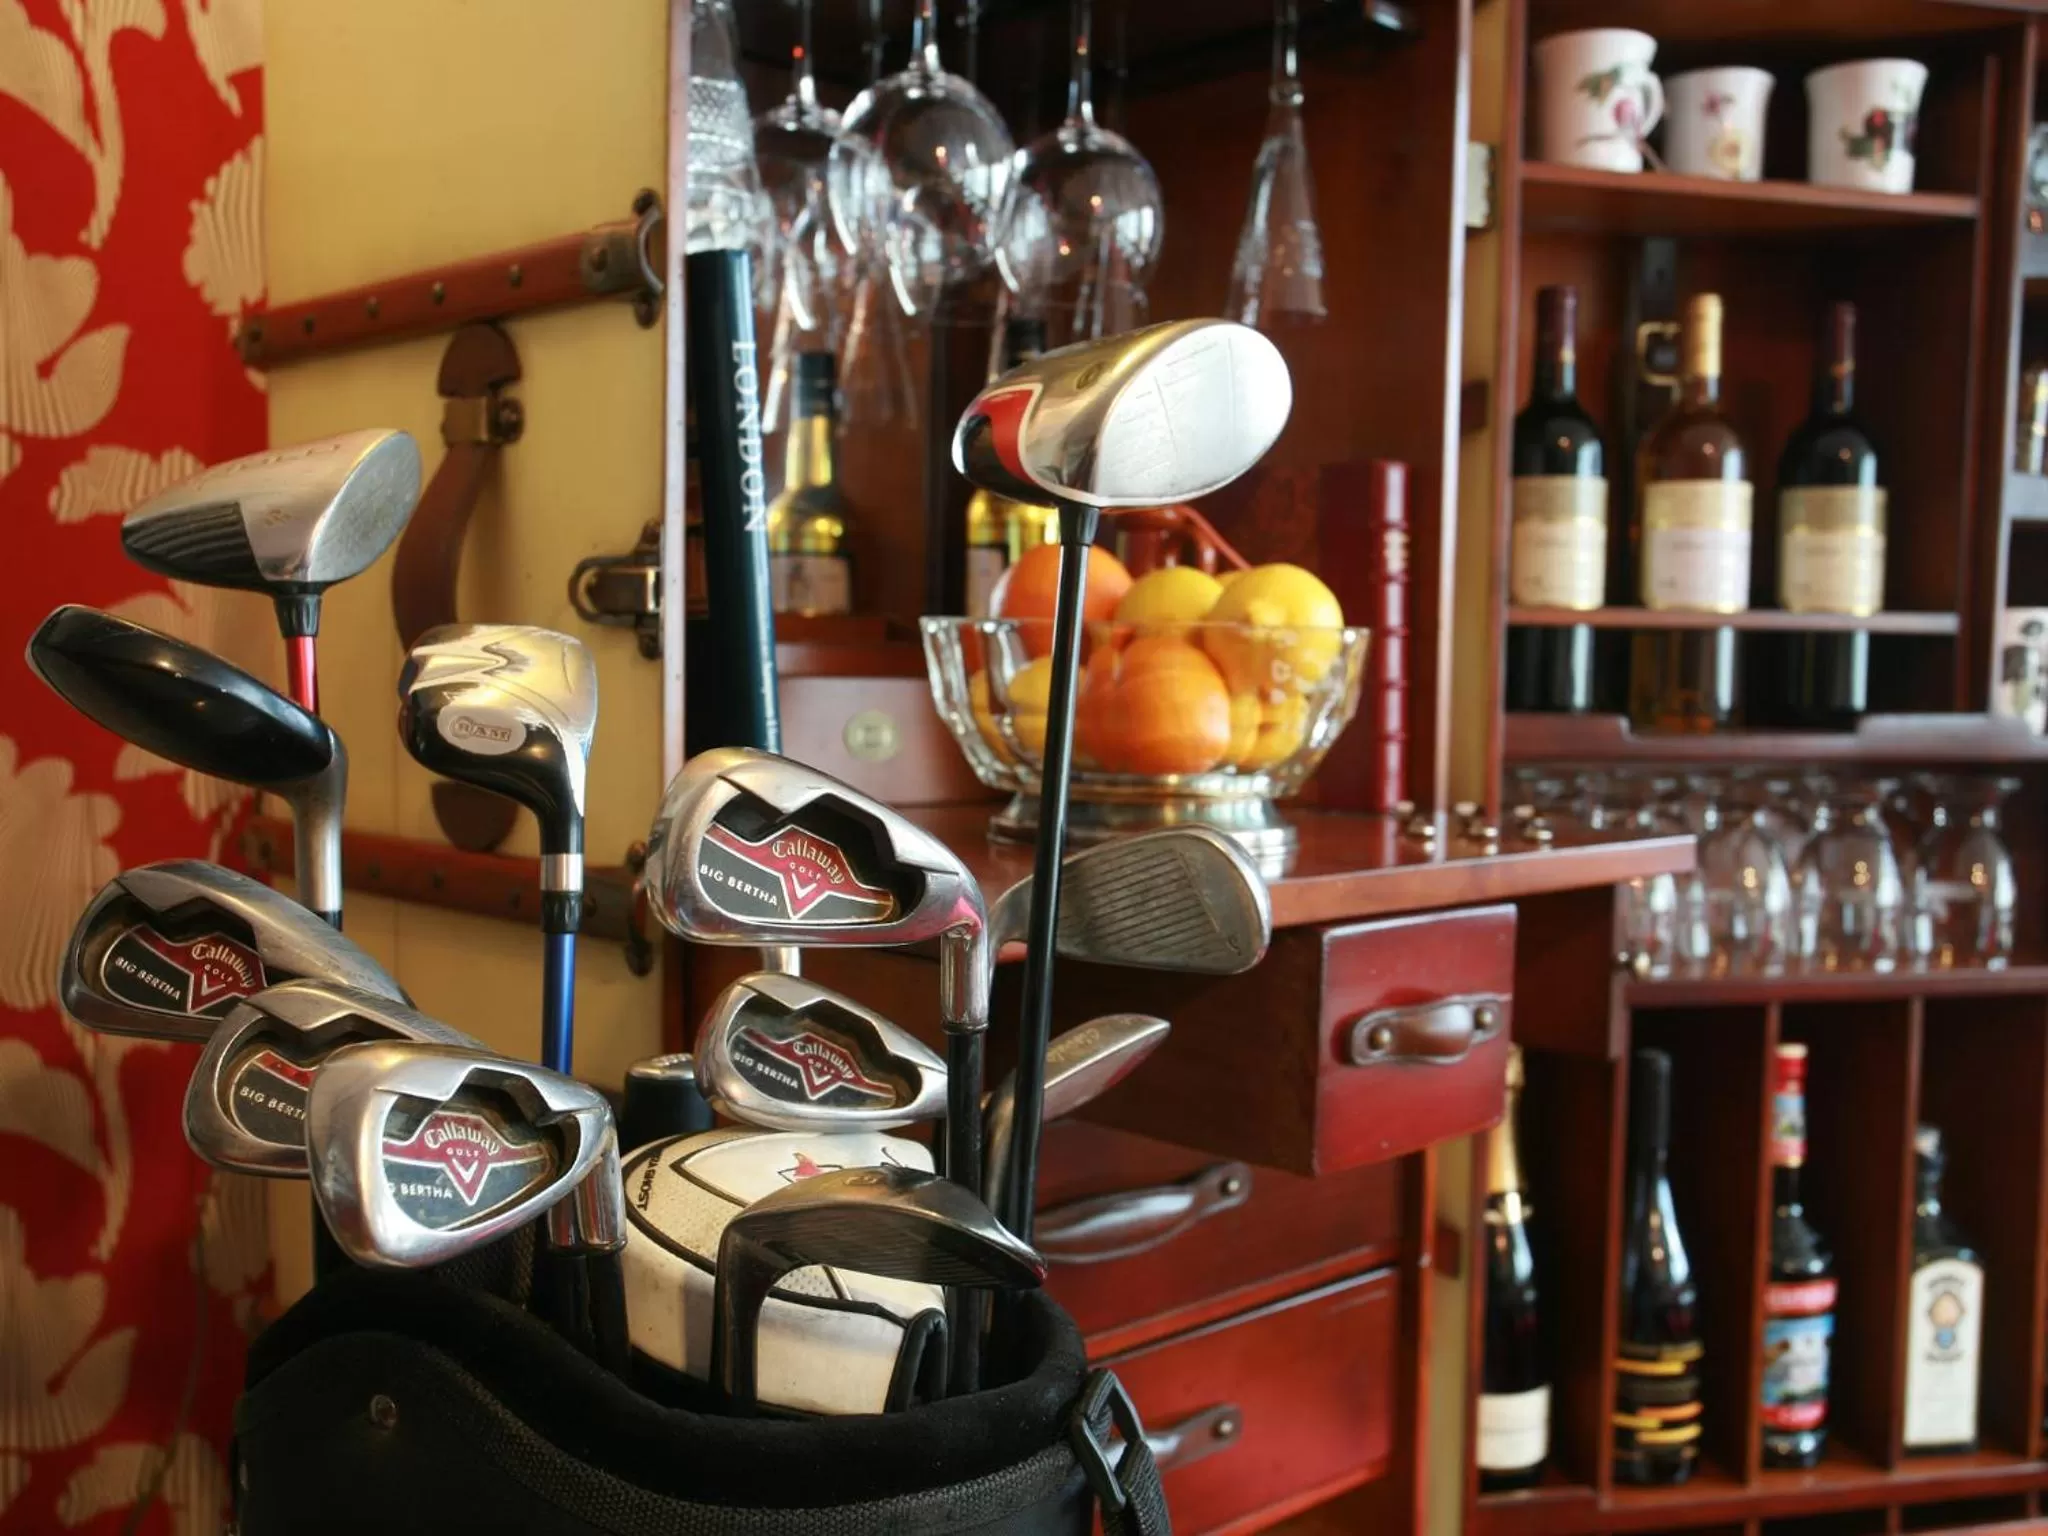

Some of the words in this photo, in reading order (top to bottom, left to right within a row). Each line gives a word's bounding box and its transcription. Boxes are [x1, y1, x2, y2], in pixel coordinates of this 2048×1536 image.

[732, 341, 766, 531] LONDON
[450, 716, 512, 742] RAM
[772, 840, 845, 885] Callaway
[790, 862, 821, 881] GOLF
[700, 864, 723, 882] BIG
[728, 875, 778, 906] BERTHA
[115, 956, 137, 974] BIG
[137, 968, 181, 1000] BERTHA
[191, 943, 256, 988] Callaway
[204, 964, 233, 982] GOLF
[733, 1052, 753, 1067] BIG
[757, 1063, 799, 1089] BERTHA
[793, 1040, 856, 1080] Callaway
[239, 1086, 265, 1103] BIG
[268, 1098, 307, 1120] BERT
[424, 1121, 501, 1156] Callaway
[446, 1147, 480, 1157] GOLF
[400, 1182, 453, 1200] BERTHA
[637, 1169, 656, 1211] GHOST
